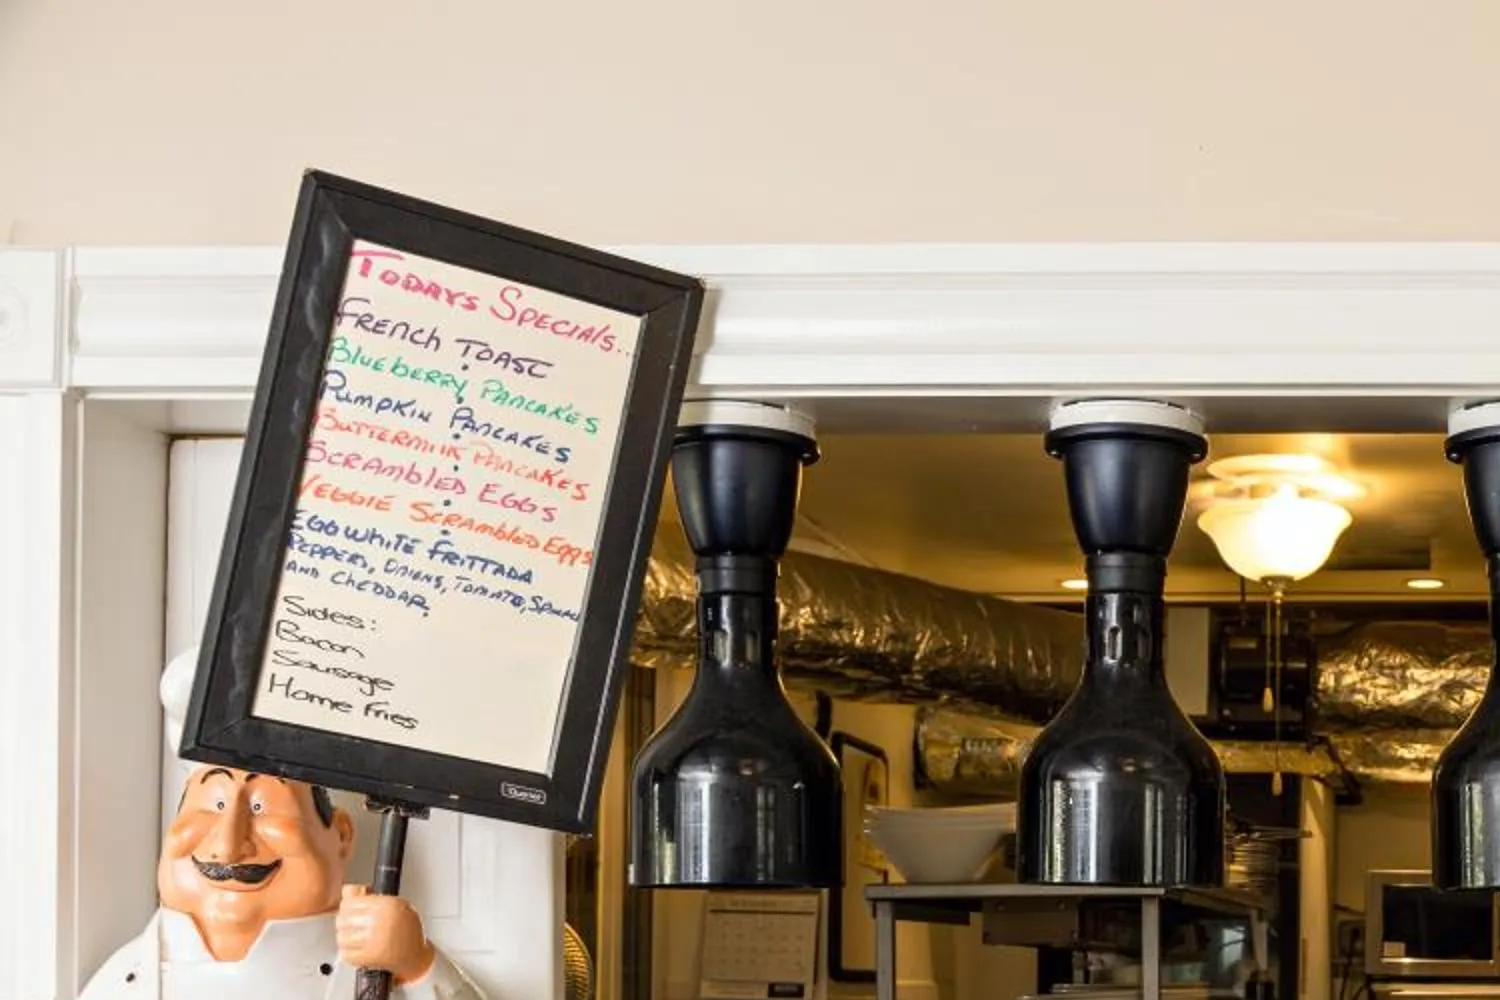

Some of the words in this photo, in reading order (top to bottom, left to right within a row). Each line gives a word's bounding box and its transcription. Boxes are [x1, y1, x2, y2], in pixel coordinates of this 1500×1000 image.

[455, 338, 553, 378] TOAST
[479, 482, 557, 523] EGGS
[269, 673, 353, 713] Home
